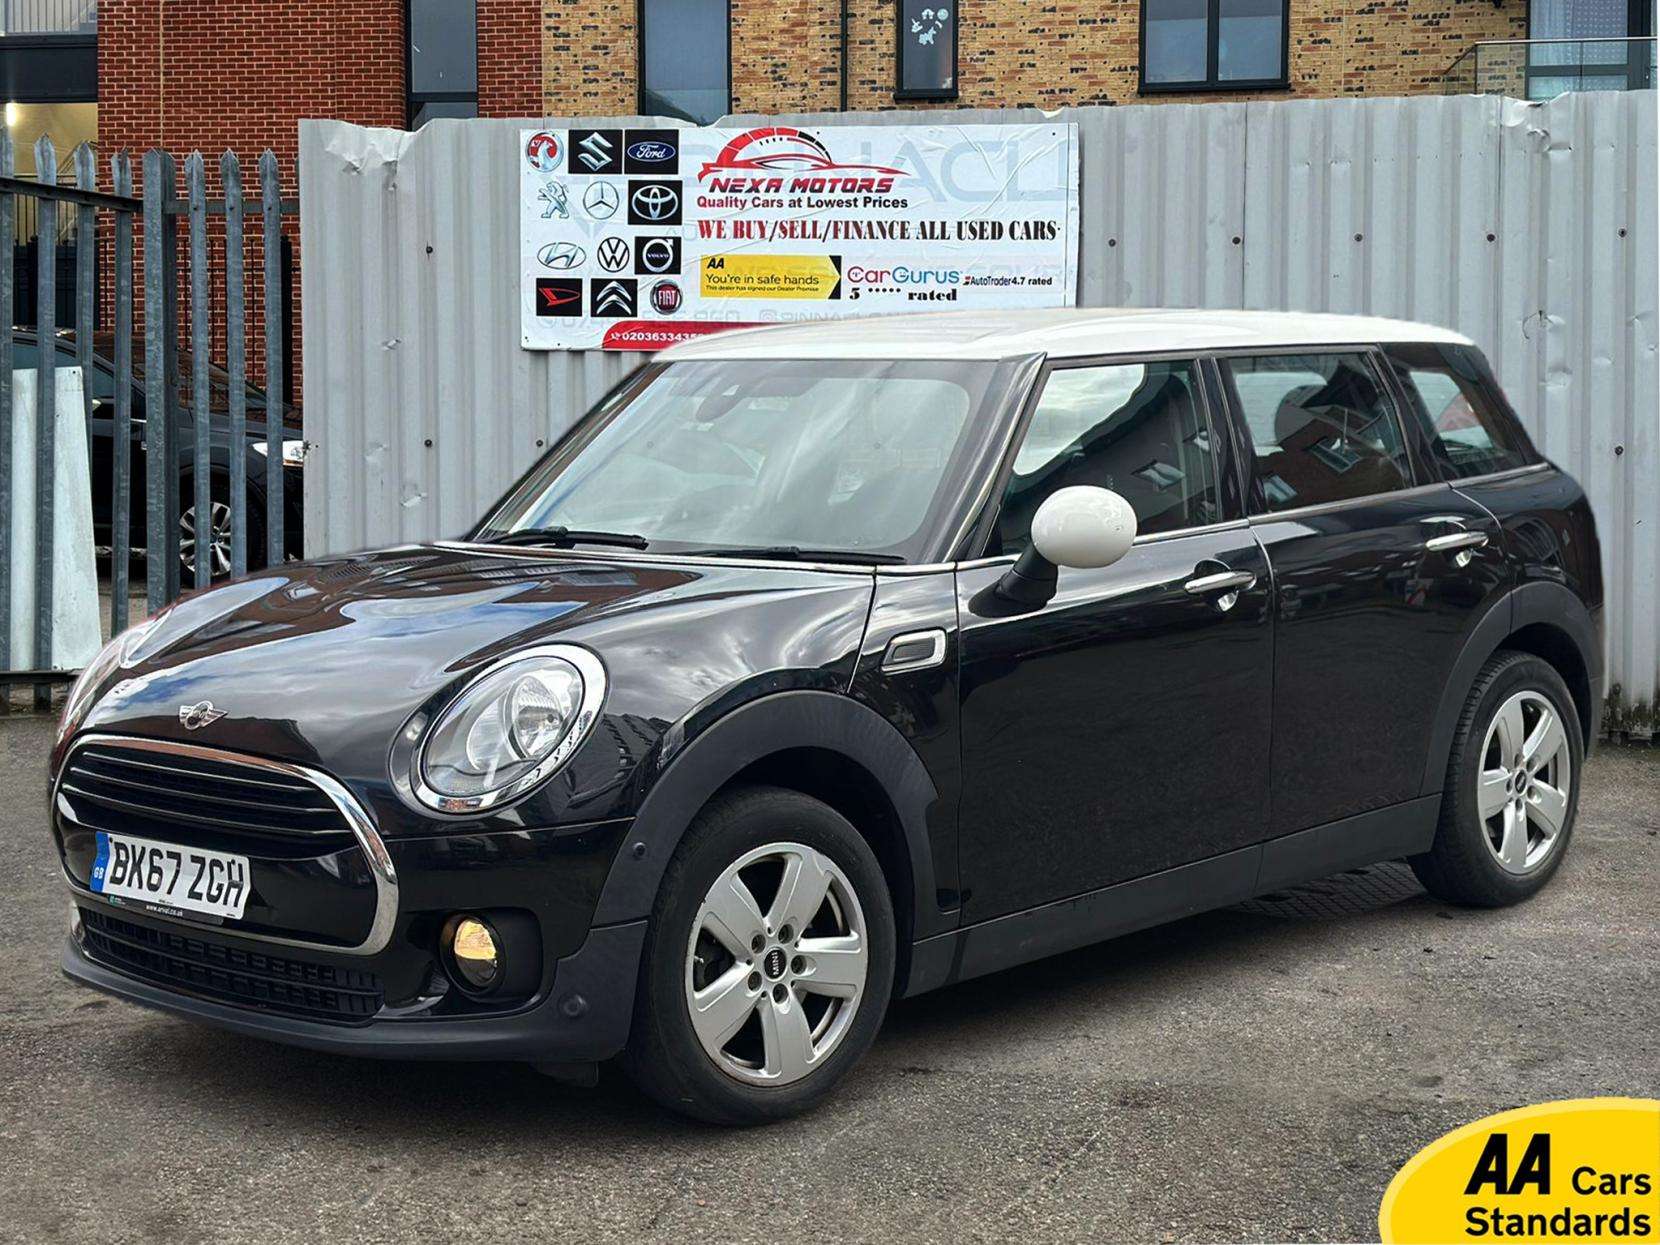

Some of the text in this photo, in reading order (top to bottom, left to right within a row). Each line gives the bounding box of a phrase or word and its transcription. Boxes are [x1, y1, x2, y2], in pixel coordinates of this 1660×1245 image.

[636, 144, 666, 159] Ford
[709, 178, 893, 193] NEXA MOTORS
[697, 196, 908, 209] Quality Cars at Lowest Prices
[698, 220, 726, 239] WE
[916, 221, 950, 240] ALL
[957, 221, 1004, 240] USED
[1009, 221, 1057, 240] CARS
[707, 258, 725, 269] AA
[706, 274, 819, 285] You're in safe hands
[847, 266, 959, 283] CarGurus
[1028, 277, 1052, 286] rated
[658, 290, 676, 305] FIAT
[850, 287, 957, 301] 5 rated
[93, 866, 104, 879] GB
[109, 841, 243, 908] BK67 ZGH
[771, 951, 780, 976] MINI
